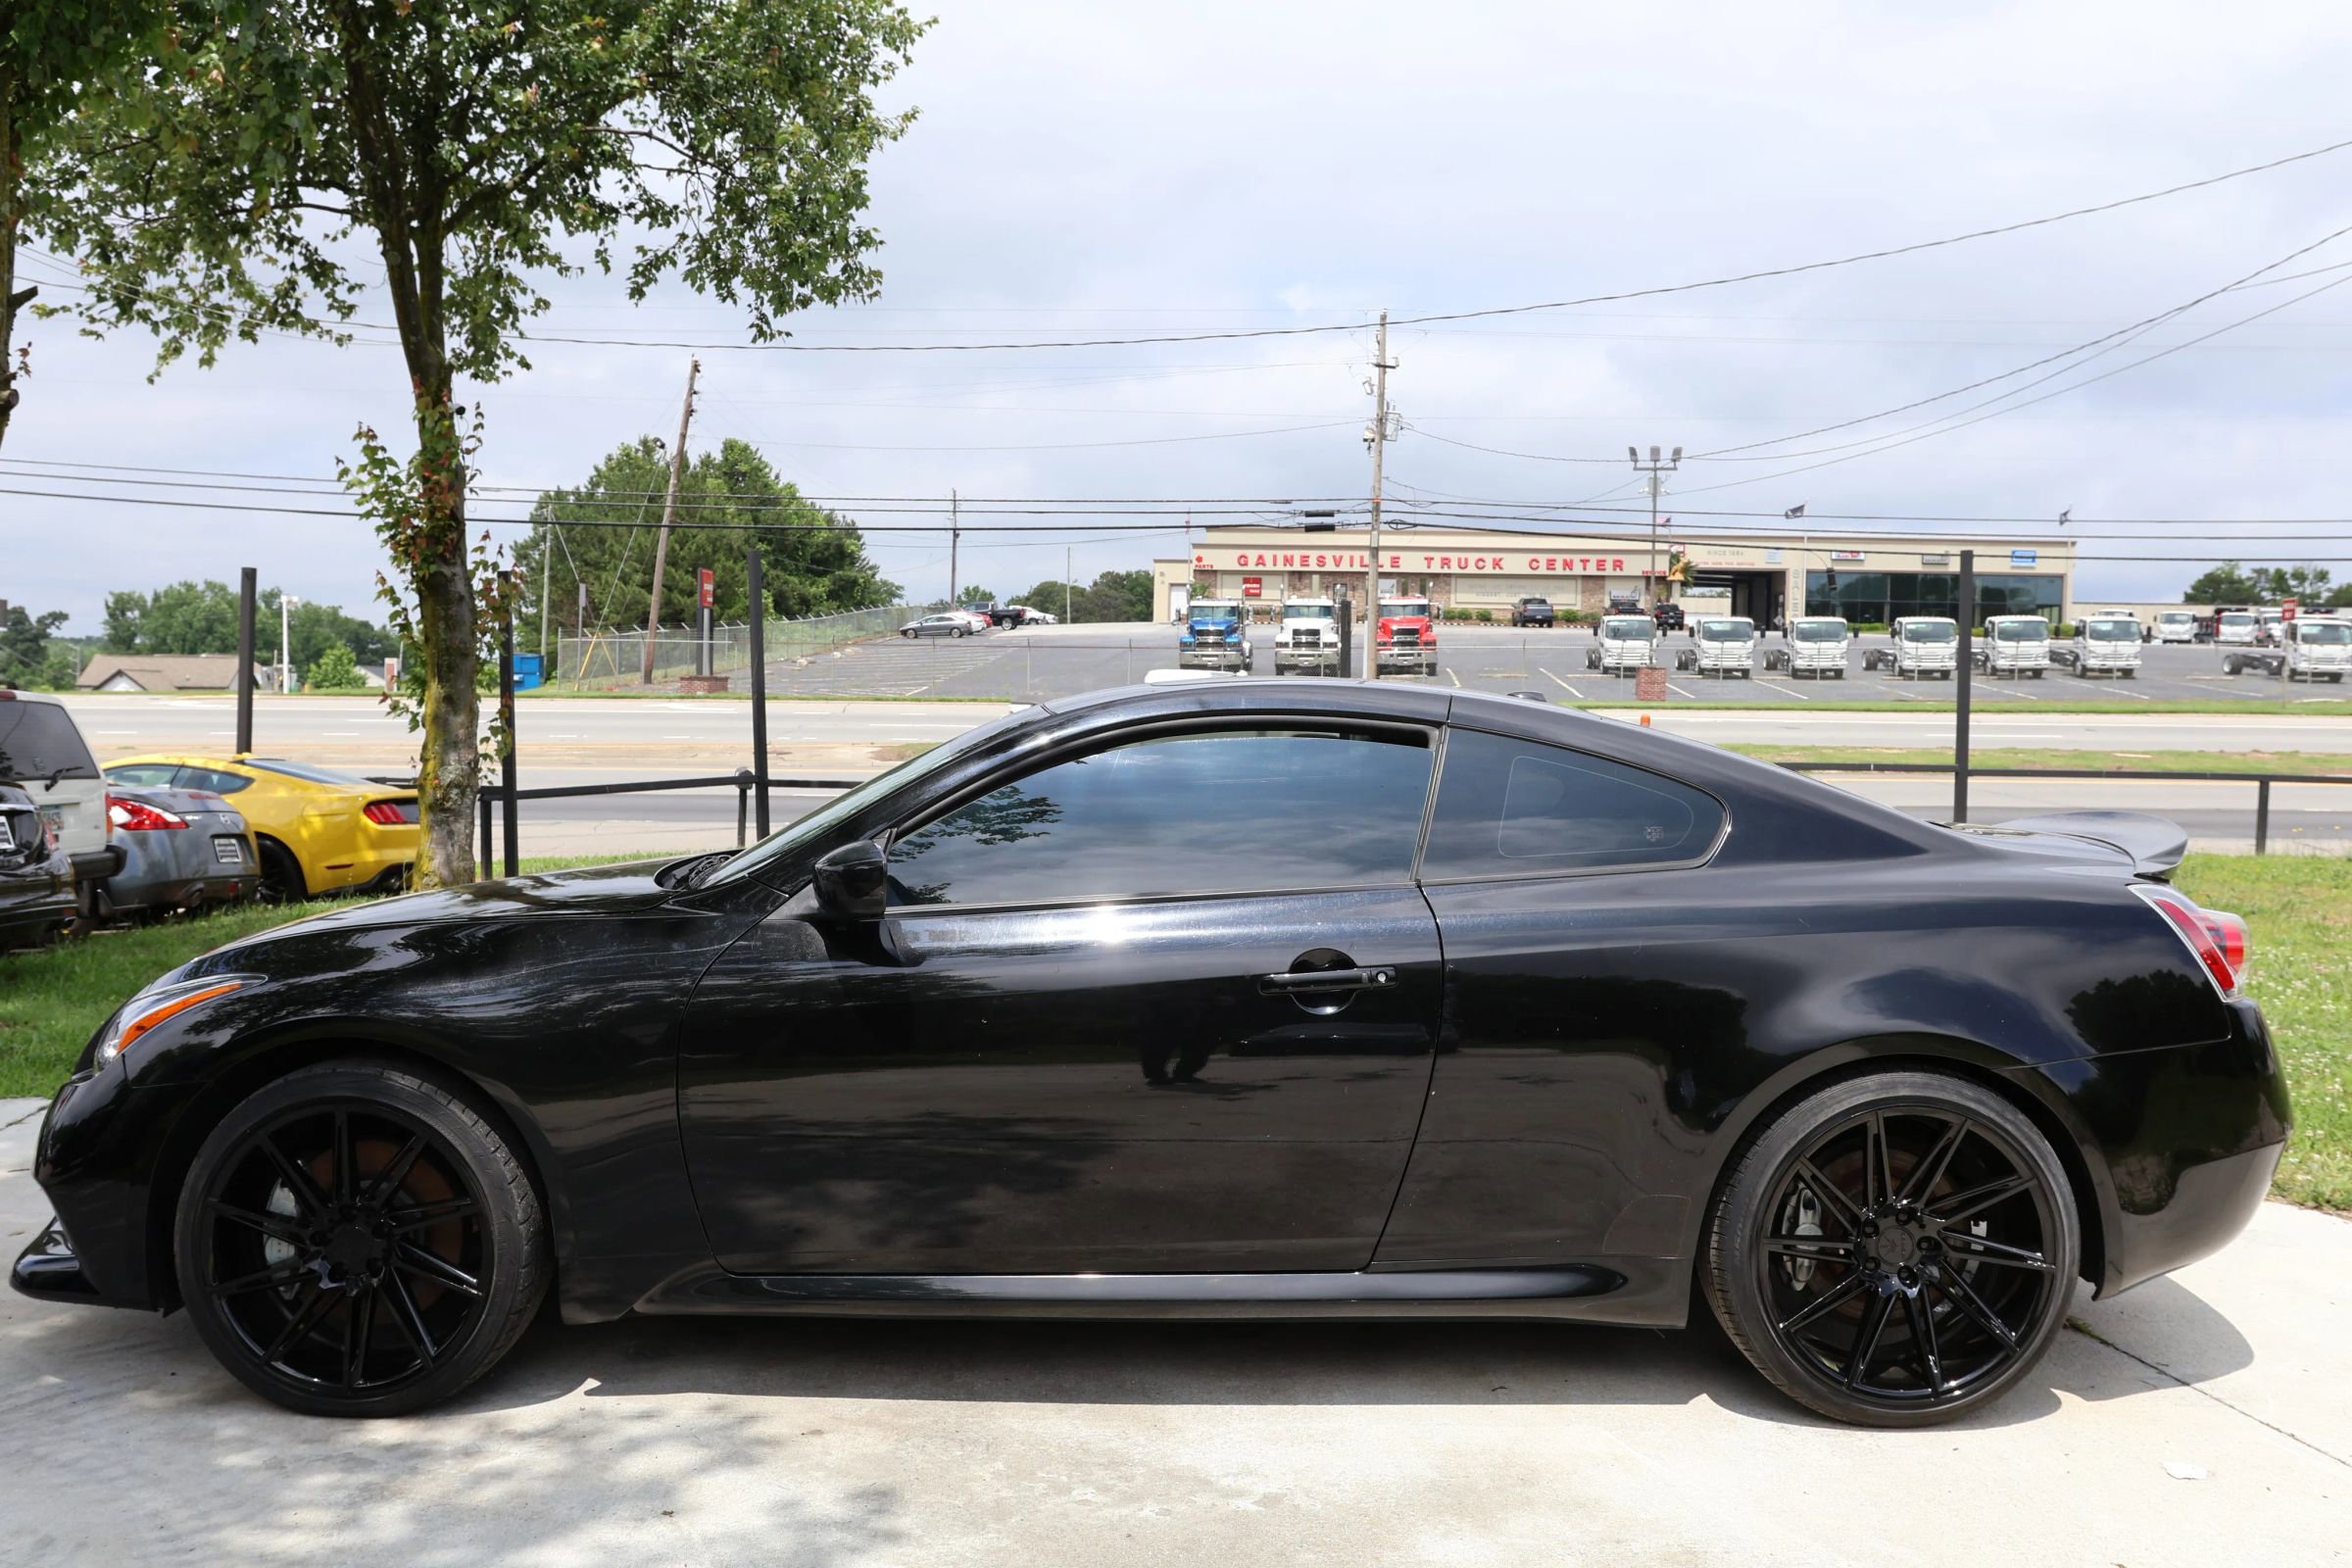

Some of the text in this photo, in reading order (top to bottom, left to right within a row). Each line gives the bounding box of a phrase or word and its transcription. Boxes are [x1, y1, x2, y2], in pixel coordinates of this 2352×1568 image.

[1237, 554, 1625, 571] GAINESVILE TRUCK CENTER
